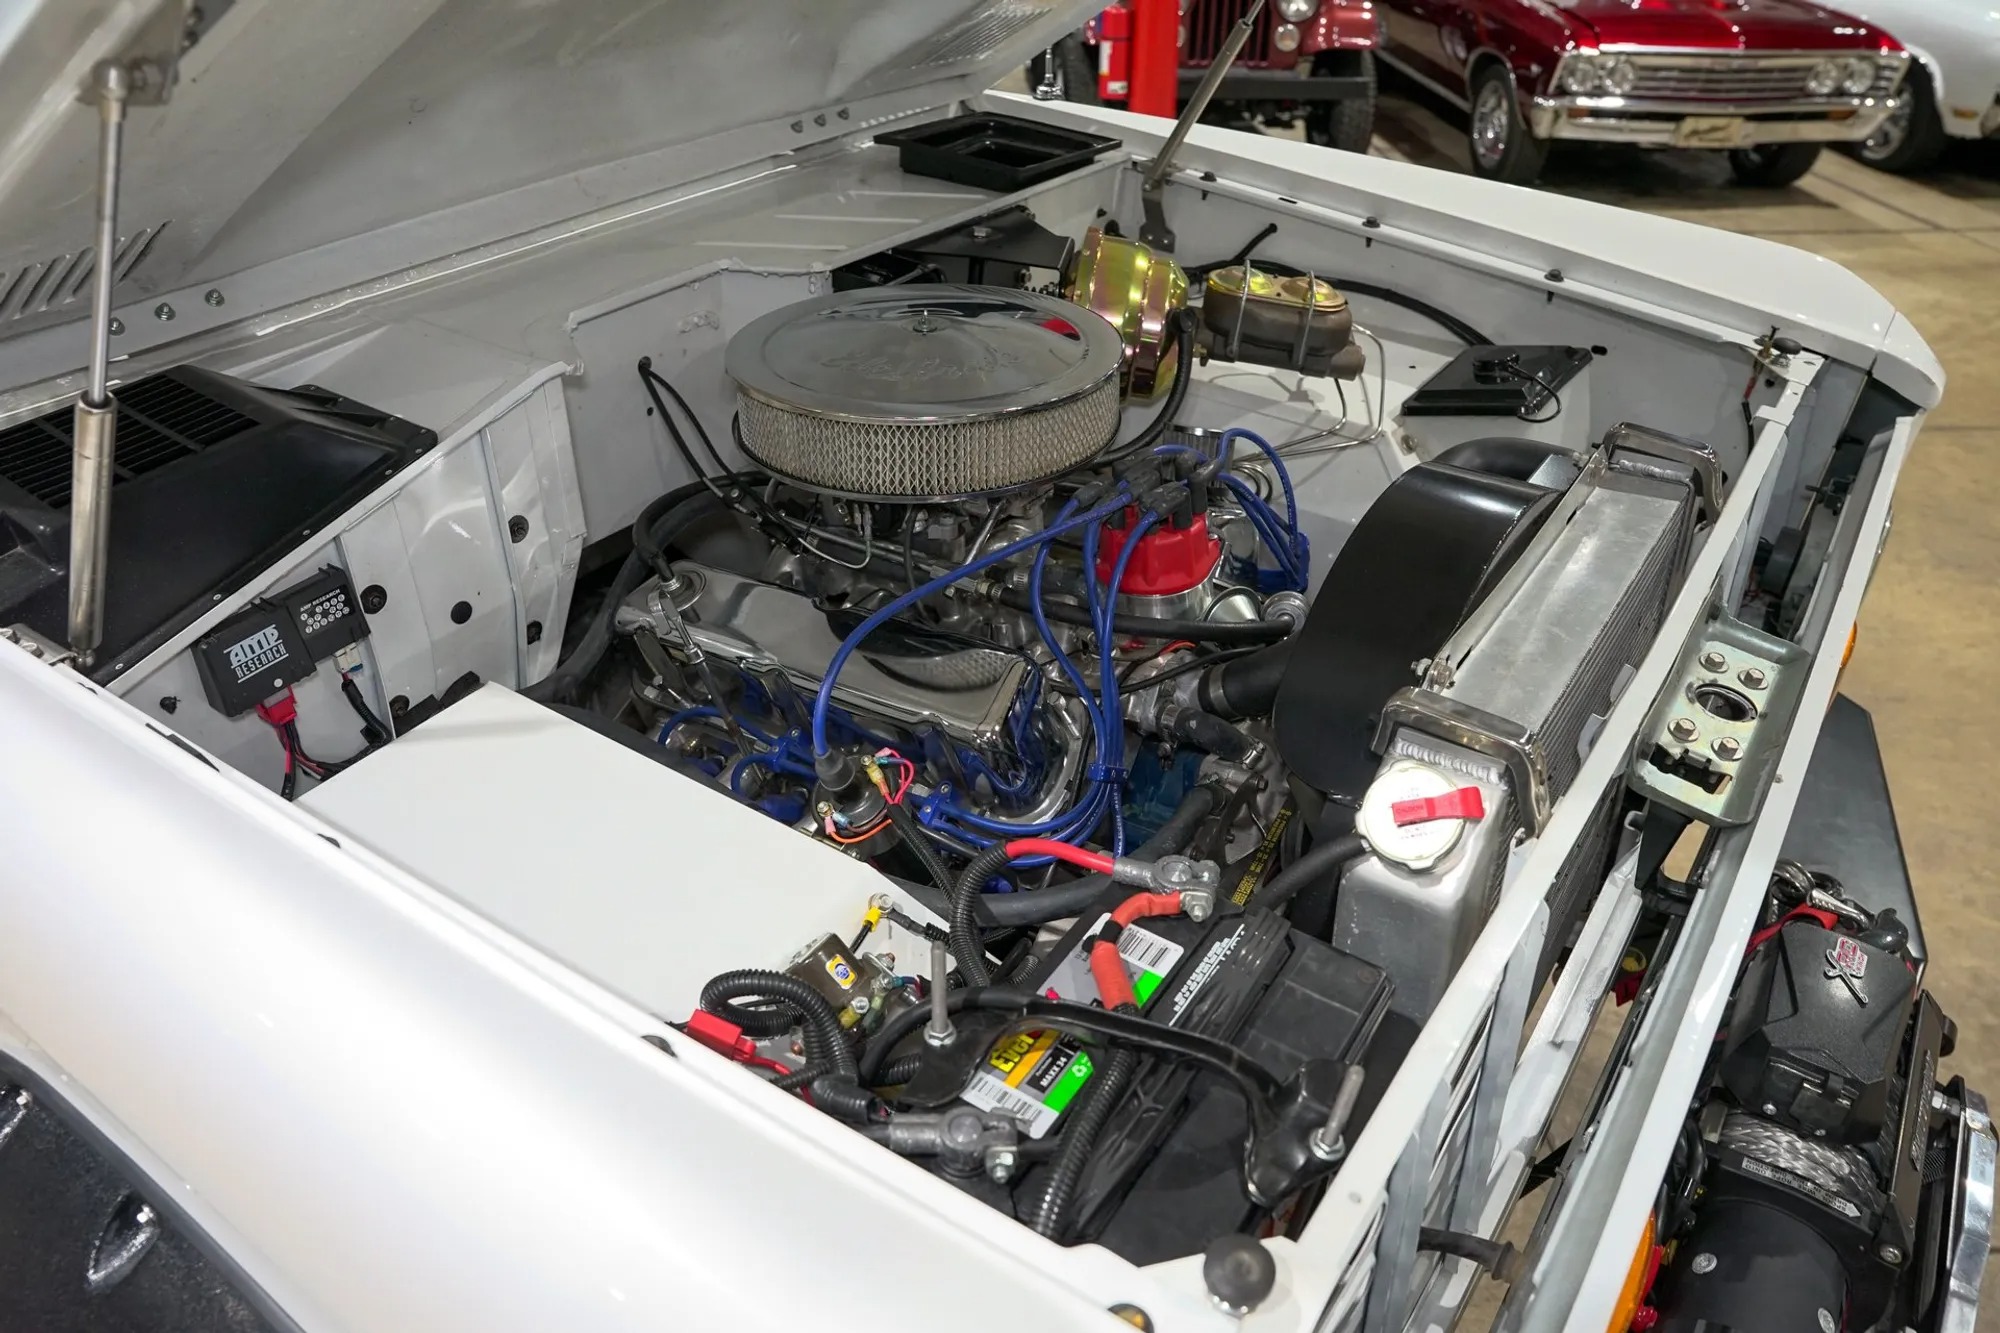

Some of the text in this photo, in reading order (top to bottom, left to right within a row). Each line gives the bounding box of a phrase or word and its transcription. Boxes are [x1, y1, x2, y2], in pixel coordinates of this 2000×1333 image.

[230, 625, 287, 678] AMP RESEARCH
[1039, 1056, 1068, 1088] MAXX 34
